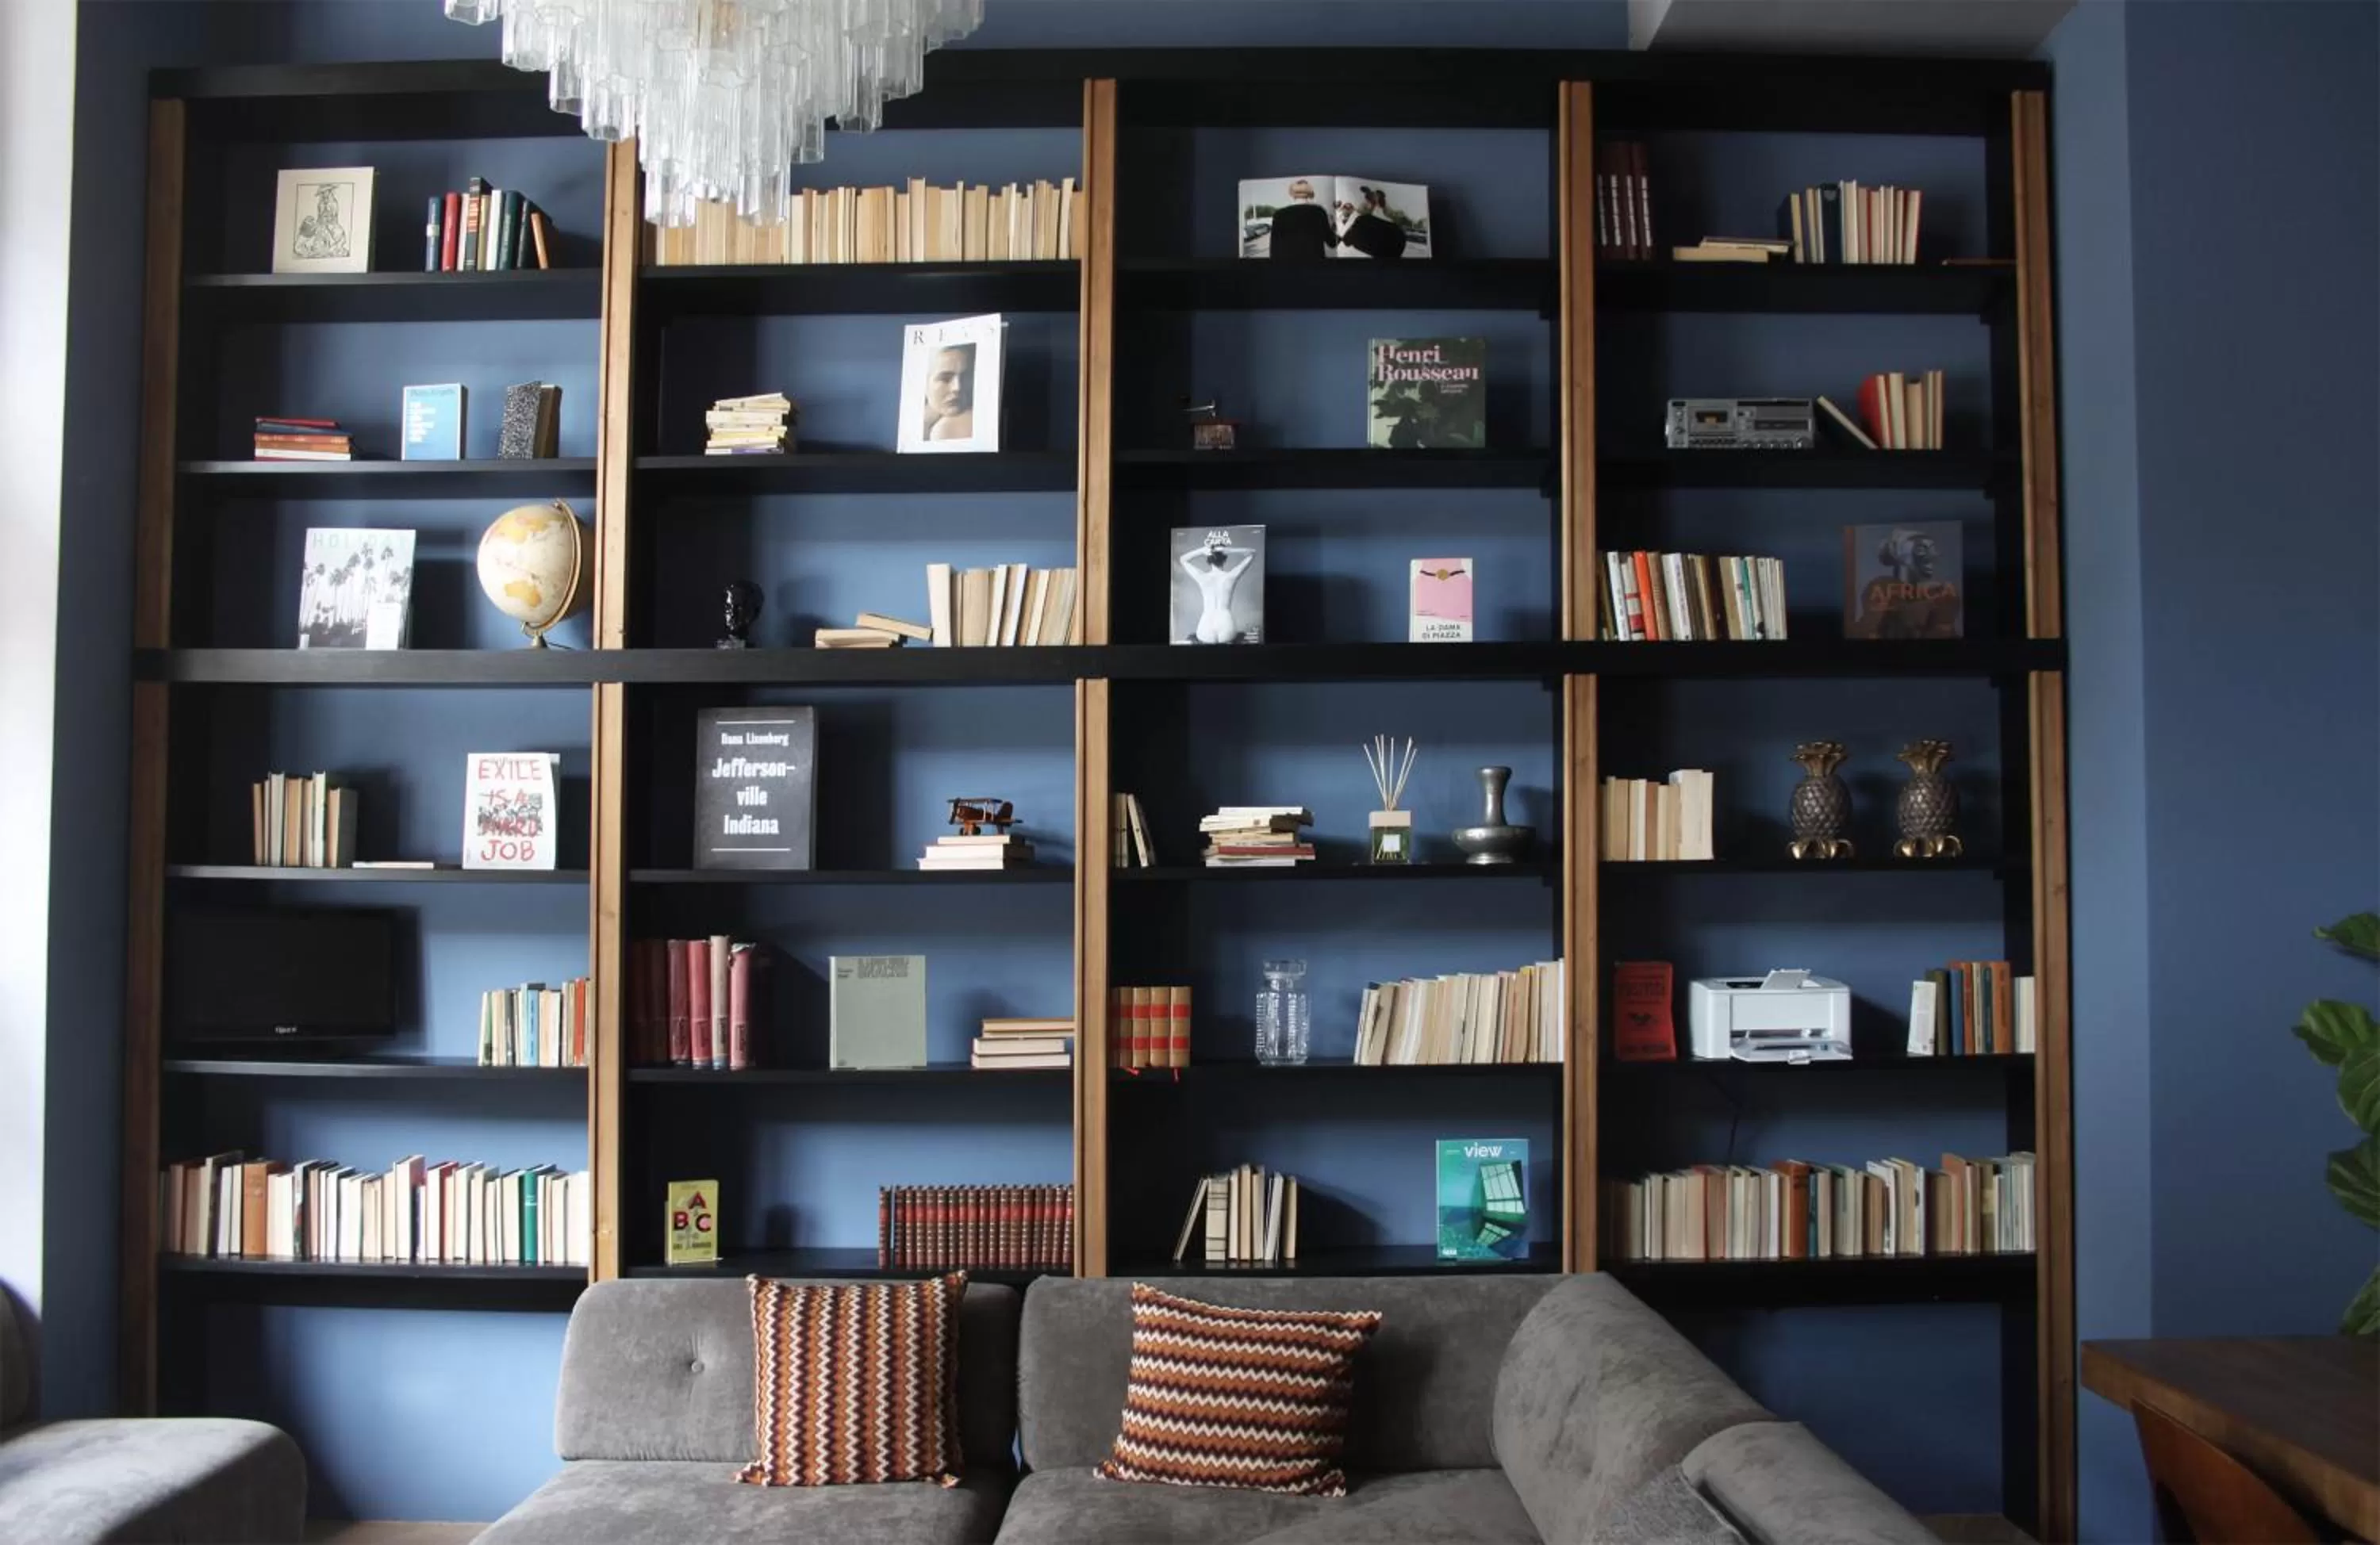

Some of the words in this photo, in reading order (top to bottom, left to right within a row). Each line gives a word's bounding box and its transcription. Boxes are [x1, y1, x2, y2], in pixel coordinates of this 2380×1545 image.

[1378, 344, 1441, 364] Henri
[1378, 364, 1479, 381] Rousseau
[1870, 583, 1957, 601] AFRICA
[478, 758, 543, 780] EXILE
[712, 757, 796, 778] Jefferson-
[736, 785, 768, 807] ville
[723, 814, 781, 834] Indiana
[480, 839, 536, 862] JOB
[1463, 1142, 1503, 1158] view
